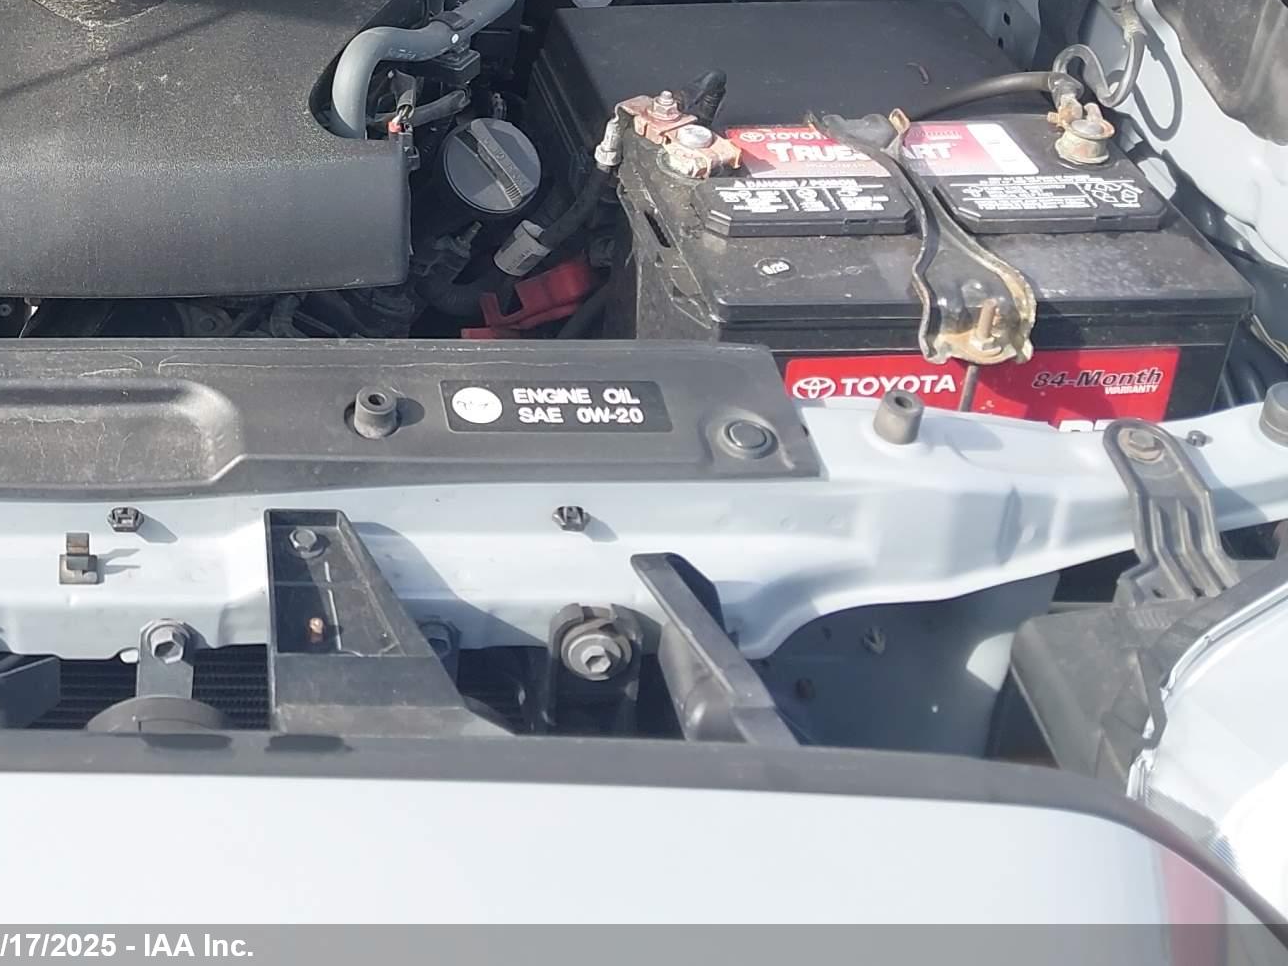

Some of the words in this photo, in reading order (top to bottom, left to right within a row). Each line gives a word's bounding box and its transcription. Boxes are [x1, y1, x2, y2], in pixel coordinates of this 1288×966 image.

[767, 132, 828, 141] TOYOT
[841, 374, 956, 396] TOYOTA
[1032, 367, 1163, 388] 84-Month
[1104, 384, 1158, 395] WARRANTY
[512, 387, 592, 404] ENGINE
[602, 388, 640, 404] OIL
[518, 407, 564, 423] SAE
[576, 407, 644, 424] 0W-20
